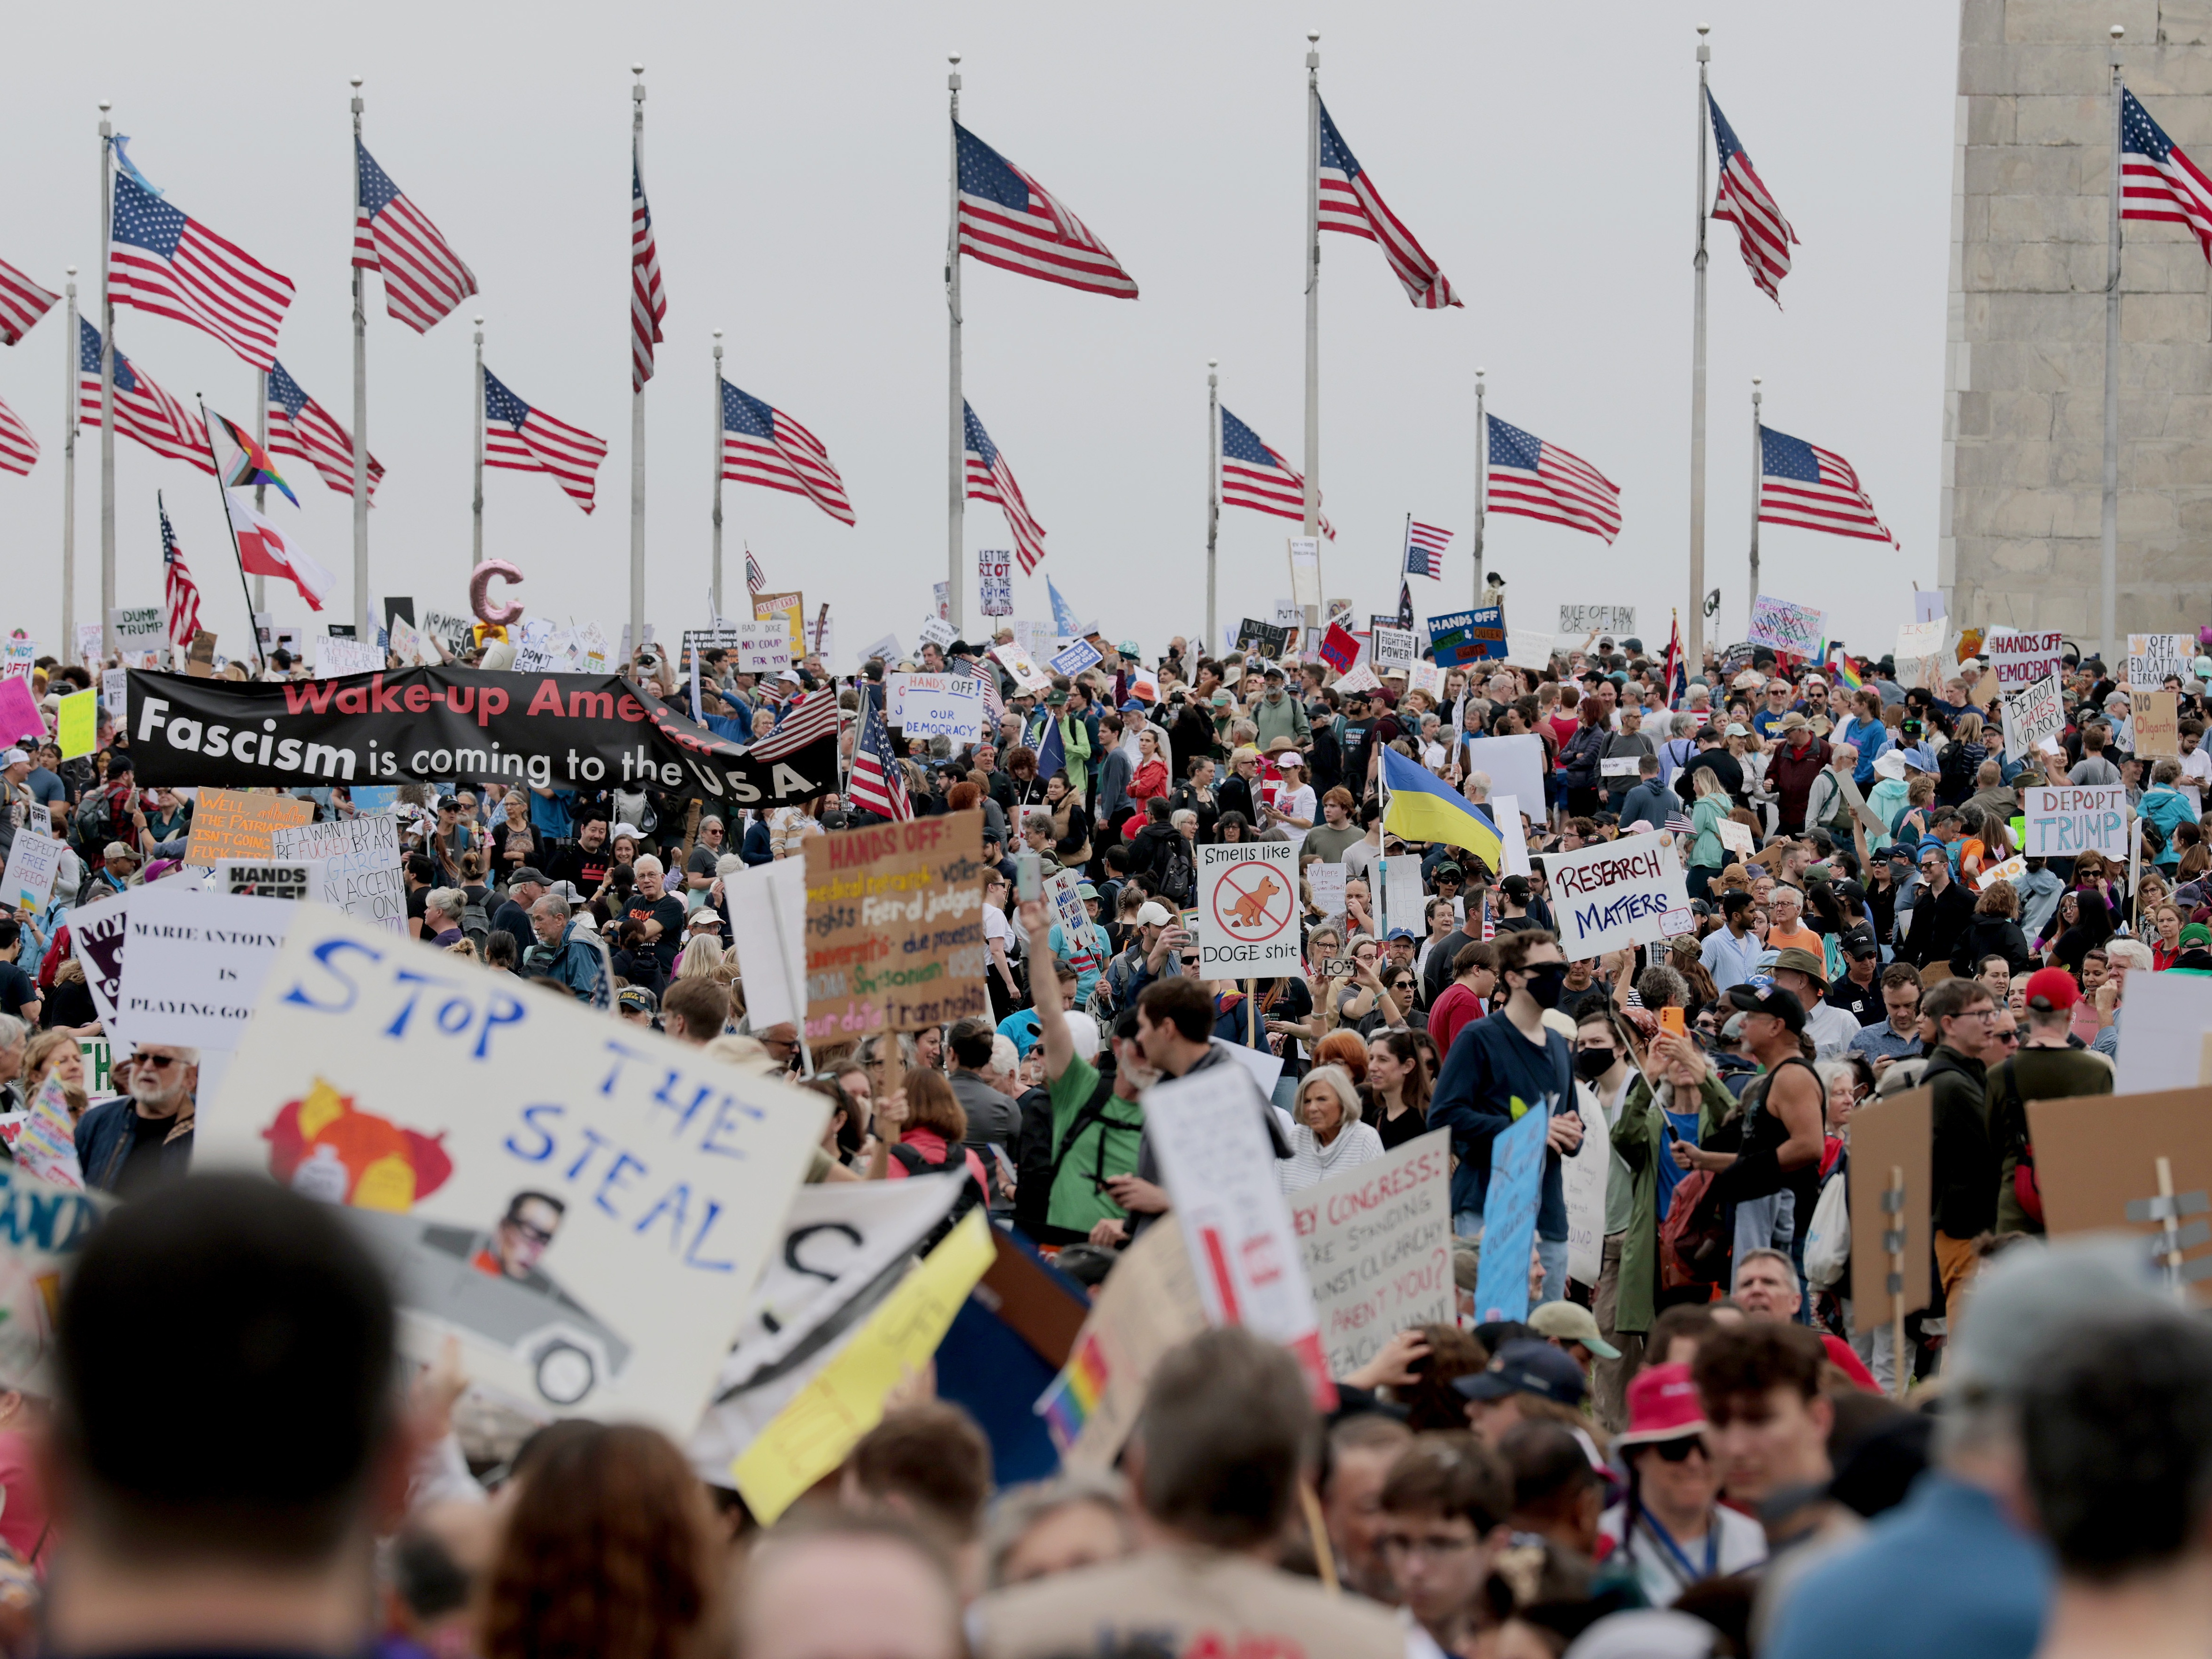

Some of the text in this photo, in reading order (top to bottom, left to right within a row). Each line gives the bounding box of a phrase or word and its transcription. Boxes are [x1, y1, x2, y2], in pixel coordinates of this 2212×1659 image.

[980, 551, 1010, 562] LET THE
[979, 563, 1010, 577] RIOT
[984, 578, 1011, 587] BE THE
[980, 588, 1010, 599] RHYME
[757, 596, 798, 614] KLEPTOCRAT
[981, 605, 1013, 615] UNHEARD
[1561, 606, 1634, 621] RULE OF LAW
[123, 609, 158, 622] DUMP
[423, 611, 467, 638] NO MORE
[1429, 611, 1498, 632] HANDS OFF
[116, 622, 163, 636] TRUMP
[579, 622, 599, 642] POWER
[765, 624, 782, 633] DOGE
[1244, 620, 1285, 641] UNITED
[1474, 628, 1502, 640] QUEER
[1562, 620, 1583, 632] OR
[1903, 620, 1939, 634] IKEA
[332, 638, 357, 650] CALL
[360, 642, 379, 654] HIM
[742, 640, 754, 650] NO
[759, 638, 782, 648] COUP
[1237, 637, 1276, 658] SND
[1382, 637, 1412, 649] FIGHT THE
[1996, 633, 2062, 654] HANDS OFF
[2150, 636, 2174, 646] OFF
[324, 647, 380, 664] A CUNT BUT
[522, 647, 553, 668] DON'T
[753, 654, 788, 665] FOR YOU
[1057, 650, 1076, 665] SHOW
[1060, 649, 1090, 670] STAND UP
[1381, 646, 1412, 661] POWER!
[1457, 645, 1487, 659] RIGHTS
[2147, 646, 2174, 658] NIH
[327, 655, 376, 670] HE LACKS
[582, 657, 606, 673] LETS
[1062, 653, 1096, 676] SPEAK OUT
[2131, 658, 2193, 673] EDUCATION &
[909, 675, 982, 697] HANDS OFF!
[2009, 675, 2055, 720] DETROIT
[2134, 694, 2151, 712] NO
[282, 674, 727, 757] Wake-up Ameica!
[930, 709, 954, 721] OUR
[2020, 696, 2056, 730] HATES
[906, 721, 977, 737] DEMOCRACY
[2016, 708, 2064, 749] KID ROCK
[2135, 715, 2176, 741] Oligarchy
[137, 696, 356, 781] Fascism
[369, 739, 398, 776] is
[411, 742, 552, 790] coming
[566, 749, 606, 782] to
[621, 745, 684, 786] the
[686, 758, 823, 804] U.S.A.
[32, 805, 46, 814] HANDS
[200, 791, 252, 817] WELL,
[2043, 790, 2122, 812] DEPORT
[32, 811, 46, 823] OFF!
[198, 813, 228, 828] THE
[193, 829, 271, 851] ISN'T GOING
[273, 816, 392, 845] IF I WANTED TO
[2033, 812, 2122, 853] TRUMP
[20, 835, 61, 859] RESPECT
[191, 845, 231, 860] FUCK
[299, 837, 350, 860] FUCKED
[351, 837, 369, 854] BY
[374, 834, 393, 850] AN
[829, 820, 898, 871] HANDS
[1204, 845, 1290, 865] Smells like
[21, 852, 48, 871] FREE
[12, 865, 49, 889] SPEECH
[230, 868, 307, 883] HANDS
[1309, 866, 1338, 877] Where
[1555, 849, 1662, 898] RESEARCH
[1992, 862, 2020, 882] NO
[347, 867, 404, 901] ACCENT,
[373, 892, 399, 919] ON
[1373, 899, 1424, 920] CNCER
[1070, 913, 1084, 930] AGAIN
[1574, 893, 1667, 940] MATTERS
[133, 921, 198, 941] MARIE
[1202, 944, 1298, 963] DOGE shit
[219, 968, 238, 982] IS
[130, 998, 215, 1019] PLAYING
[282, 938, 529, 1062] STOP
[599, 1038, 766, 1161] THE
[500, 1103, 739, 1275] STEAL
[1327, 1150, 1441, 1227] CONGRESS:
[1393, 1246, 1448, 1304] YOU?
